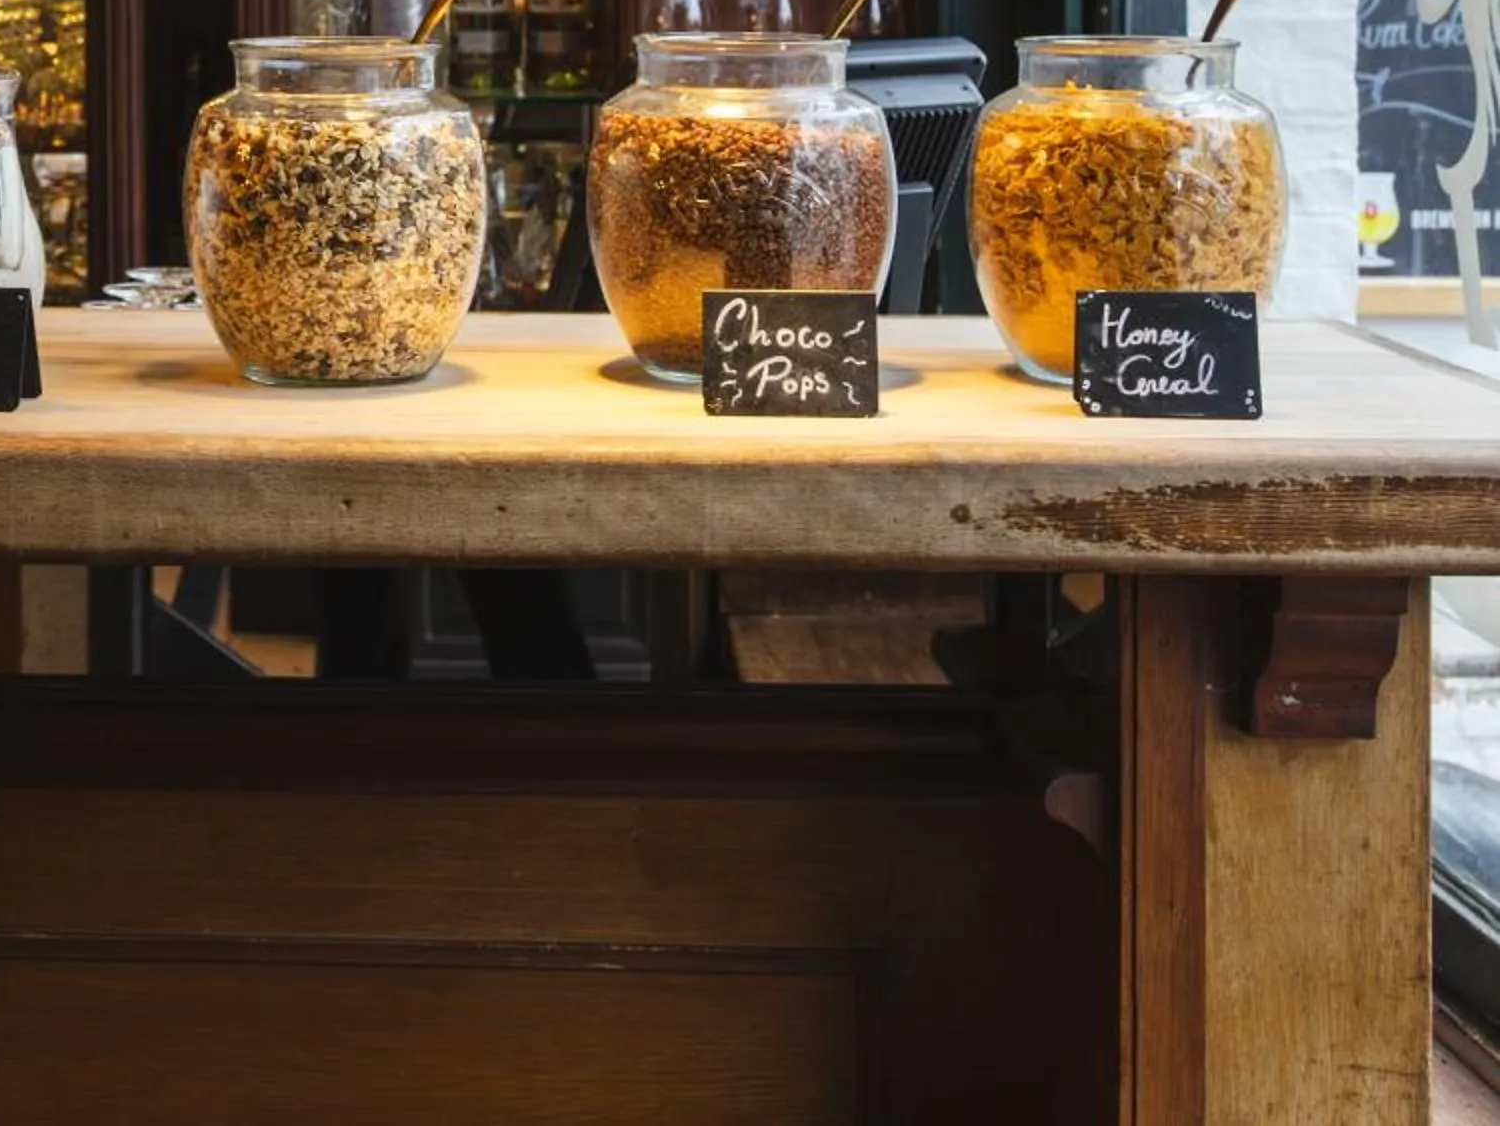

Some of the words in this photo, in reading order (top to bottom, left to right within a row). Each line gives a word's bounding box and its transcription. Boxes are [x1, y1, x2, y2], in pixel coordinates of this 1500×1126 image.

[714, 297, 833, 352] Choco
[1101, 303, 1200, 369] Honey
[746, 354, 831, 402] Pops
[1116, 353, 1219, 397] Cereal
